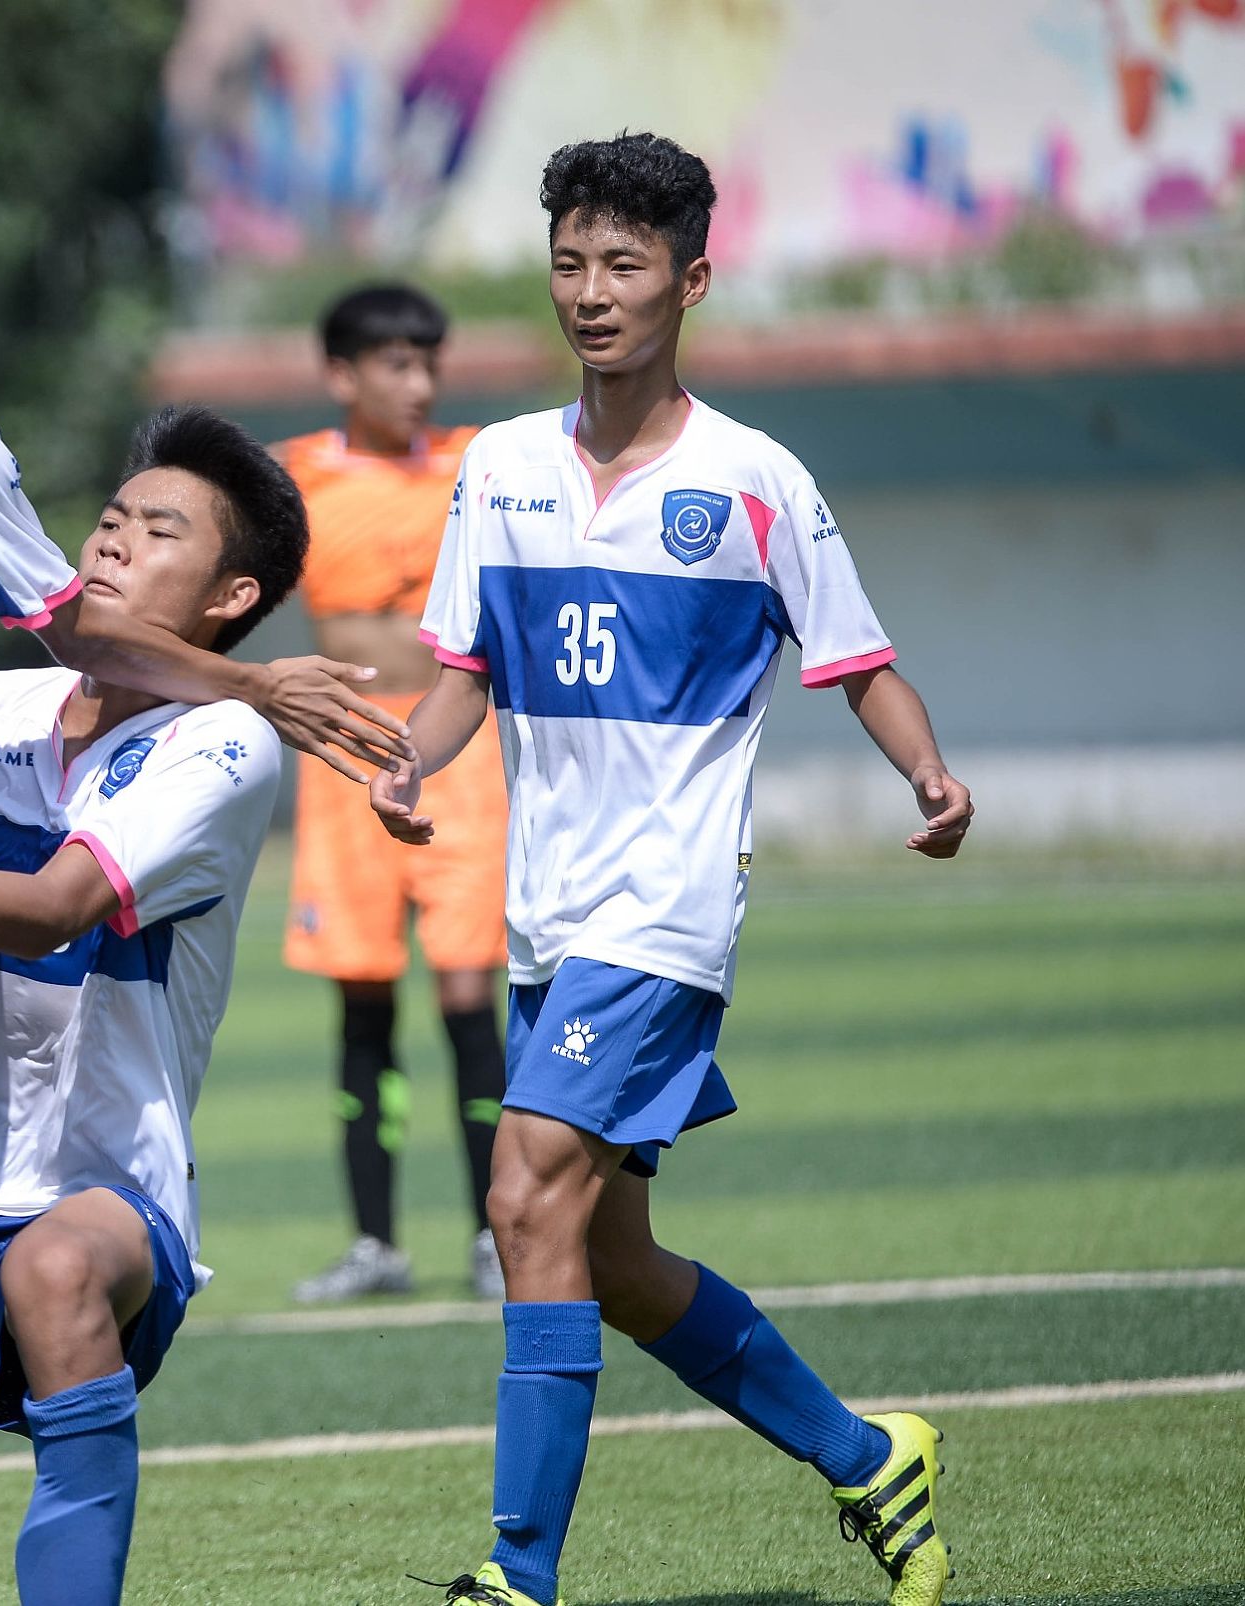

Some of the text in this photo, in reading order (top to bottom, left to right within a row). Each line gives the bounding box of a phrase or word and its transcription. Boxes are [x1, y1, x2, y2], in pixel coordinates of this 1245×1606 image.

[490, 495, 557, 513] KELME
[555, 602, 618, 687] 35
[551, 1044, 592, 1066] KELME
